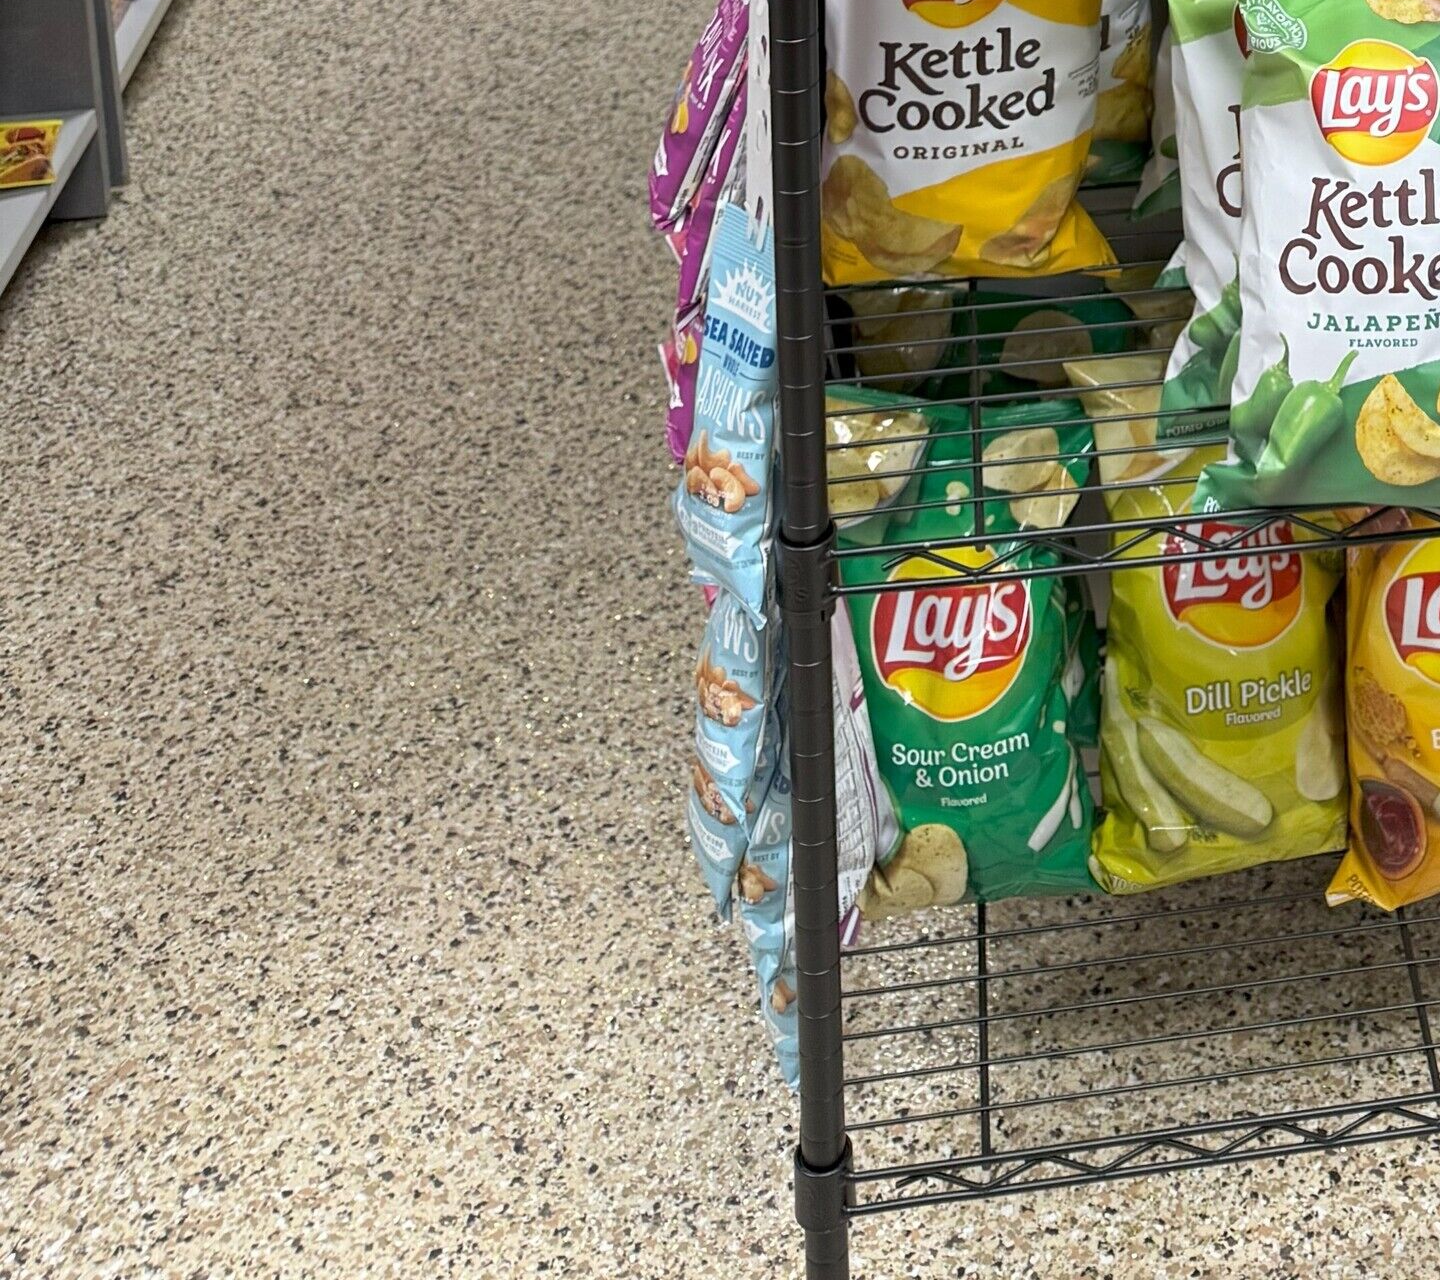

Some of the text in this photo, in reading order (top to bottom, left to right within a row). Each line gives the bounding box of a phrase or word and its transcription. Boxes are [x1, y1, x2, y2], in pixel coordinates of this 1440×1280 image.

[877, 28, 1041, 96] Kettle
[858, 68, 1055, 134] Cooked
[1318, 65, 1432, 137] Lay's
[893, 136, 1025, 161] ORIGINAL
[737, 281, 763, 306] NUT
[703, 314, 775, 369] SEA SALTED
[1349, 337, 1418, 349] FLAVORED
[1174, 523, 1291, 610] Lay's
[884, 580, 1020, 682] Lay's
[1185, 670, 1312, 716] Dill Pickle
[1225, 707, 1281, 726] Flavored
[892, 732, 1030, 767] Sour Cream
[915, 760, 1009, 788] & Onion
[940, 793, 987, 807] Flavored
